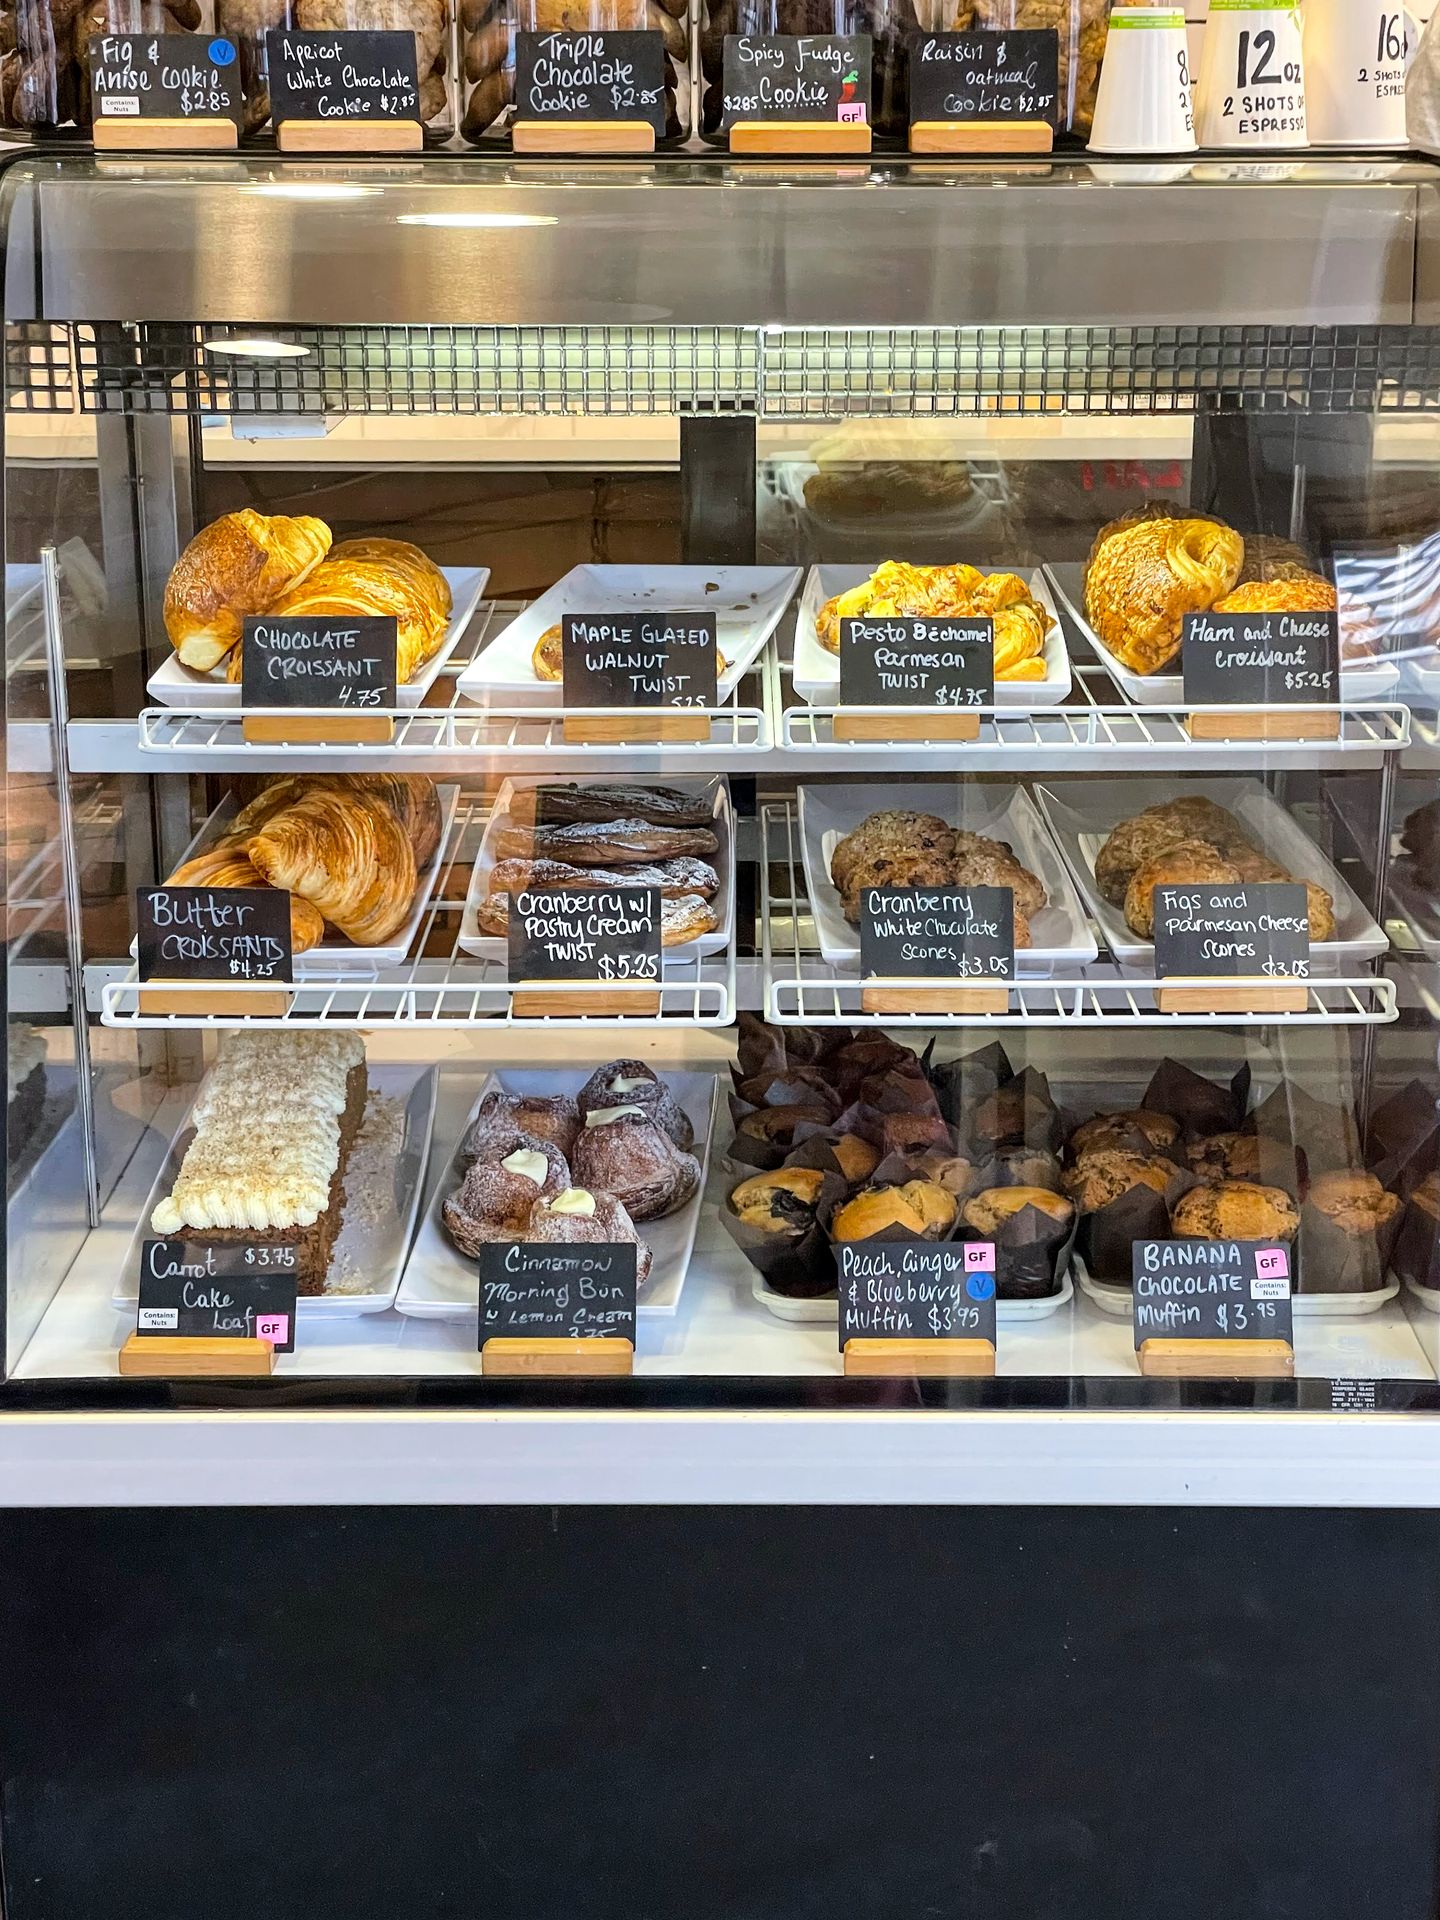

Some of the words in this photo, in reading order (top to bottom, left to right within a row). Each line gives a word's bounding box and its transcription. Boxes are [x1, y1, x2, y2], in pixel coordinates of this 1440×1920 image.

[101, 37, 133, 73] Fig
[148, 40, 160, 65] &
[217, 44, 228, 61] V
[538, 33, 605, 65] Triple
[738, 38, 785, 69] Spicy
[795, 39, 855, 74] Fudge
[922, 39, 983, 62] Raisin
[95, 67, 152, 92] Anise
[162, 65, 222, 89] Cookie
[287, 67, 332, 90] White
[342, 65, 411, 89] Chocolate
[533, 58, 634, 88] Chocolate
[966, 61, 1038, 89] oatmeal
[1177, 49, 1189, 87] 8
[1357, 68, 1368, 82] 2
[1373, 70, 1400, 81] SHOTS
[181, 88, 231, 116] $2.85
[530, 86, 591, 113] Cookie
[610, 84, 665, 111] $2.85
[760, 77, 829, 103] Cookie
[944, 90, 1012, 113] Cookie
[1019, 93, 1054, 112] $2.85
[1179, 92, 1188, 108] 2
[318, 96, 371, 117] Cookie
[380, 93, 416, 115] $2.85
[841, 113, 859, 122] GF
[1223, 96, 1234, 117] 2
[1242, 96, 1294, 114] SHOTS
[254, 625, 361, 650] CHOCOLATE
[571, 622, 632, 644] MAPLE
[641, 623, 710, 647] GLAZED
[850, 621, 906, 644] Pesto
[1189, 617, 1235, 642] Ham
[1243, 621, 1273, 641] and
[1279, 616, 1330, 638] Cheese
[267, 656, 382, 680] CROISSANT
[586, 652, 669, 671] WALNUT
[874, 647, 965, 668] Parmesan
[628, 675, 691, 693] TWIST
[878, 672, 930, 690] TWIST
[1284, 671, 1333, 690] $5.25
[338, 685, 387, 707] 4.75
[935, 685, 987, 706] $4.75
[148, 892, 255, 929] Butter
[517, 891, 624, 919] Cranberry
[629, 890, 652, 918] w/
[868, 890, 974, 920] Cranberry
[1162, 891, 1202, 920] Figs
[1209, 892, 1248, 909] and
[524, 917, 585, 945] Pastry
[586, 914, 652, 936] Cream
[874, 918, 922, 937] White
[1165, 918, 1257, 936] Parmesan
[1258, 915, 1309, 933] Cheese
[161, 931, 285, 961] CROISSANTS
[544, 942, 597, 962] TWIST
[901, 943, 957, 961] Scones
[1201, 939, 1256, 959] Scones
[229, 959, 277, 979] $4.25
[598, 953, 659, 980] $5.25
[958, 953, 1010, 978] $3.05
[1261, 954, 1310, 977] $3.05
[150, 1242, 217, 1279] Carrot
[245, 1247, 295, 1267] $3.75
[505, 1245, 612, 1273] Cinnamon
[842, 1246, 901, 1278] Peach,
[902, 1249, 962, 1282] Ginger
[968, 1252, 987, 1262] GF
[1143, 1243, 1242, 1272] BANANA
[1260, 1257, 1279, 1268] GF
[183, 1281, 235, 1309] Cake
[484, 1280, 569, 1309] Morning
[848, 1280, 860, 1306] &
[867, 1279, 961, 1309] Blueberry
[975, 1280, 986, 1294] V
[212, 1306, 255, 1338] Loaf
[508, 1310, 564, 1324] Lemon
[573, 1308, 633, 1324] Cream
[845, 1305, 913, 1331] Muffin
[928, 1303, 980, 1336] $3.95
[1137, 1301, 1200, 1328] Muffin
[261, 1323, 280, 1334] GF
